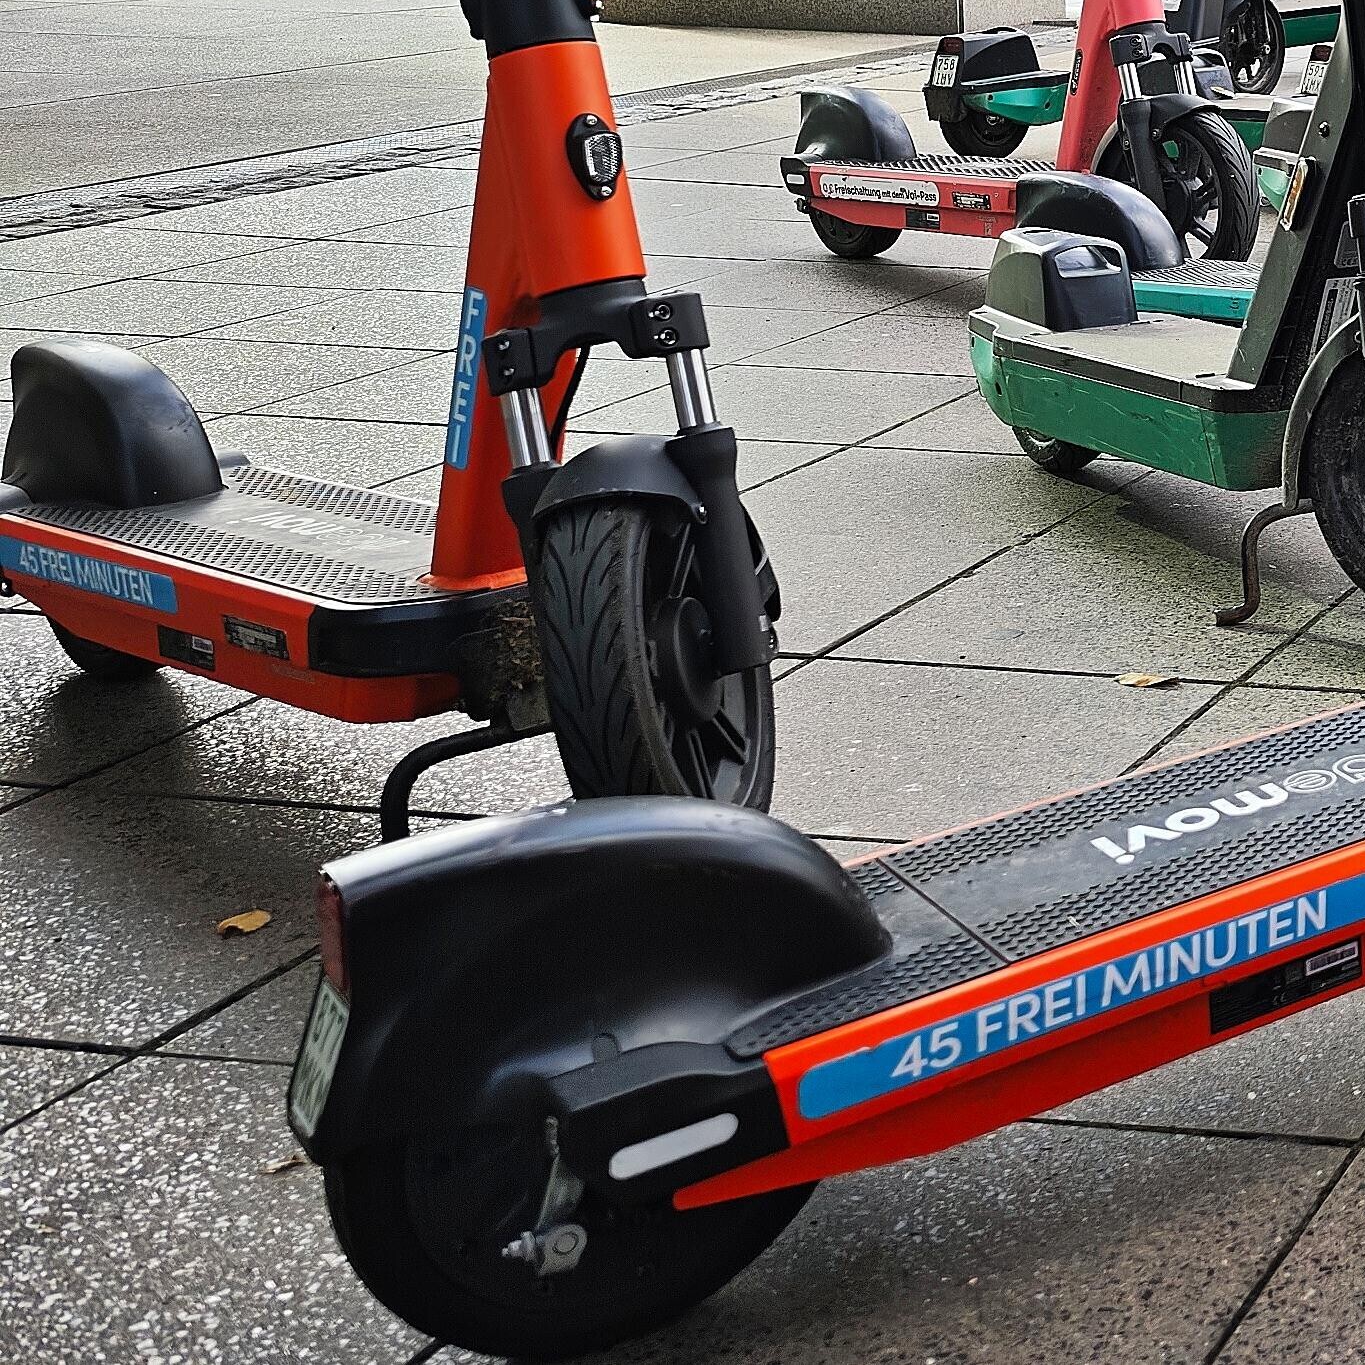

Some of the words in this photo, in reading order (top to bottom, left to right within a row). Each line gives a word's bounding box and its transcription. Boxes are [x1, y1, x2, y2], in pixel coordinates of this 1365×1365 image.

[937, 58, 955, 71] 758
[834, 184, 881, 200] Freischaltung
[452, 289, 484, 463] FREI
[18, 544, 41, 576] 45
[38, 549, 75, 583] FREI
[74, 558, 153, 605] MINUTEN
[891, 1022, 962, 1078] 45
[975, 976, 1087, 1054] FREI
[1100, 889, 1328, 1008] MINUTEN
